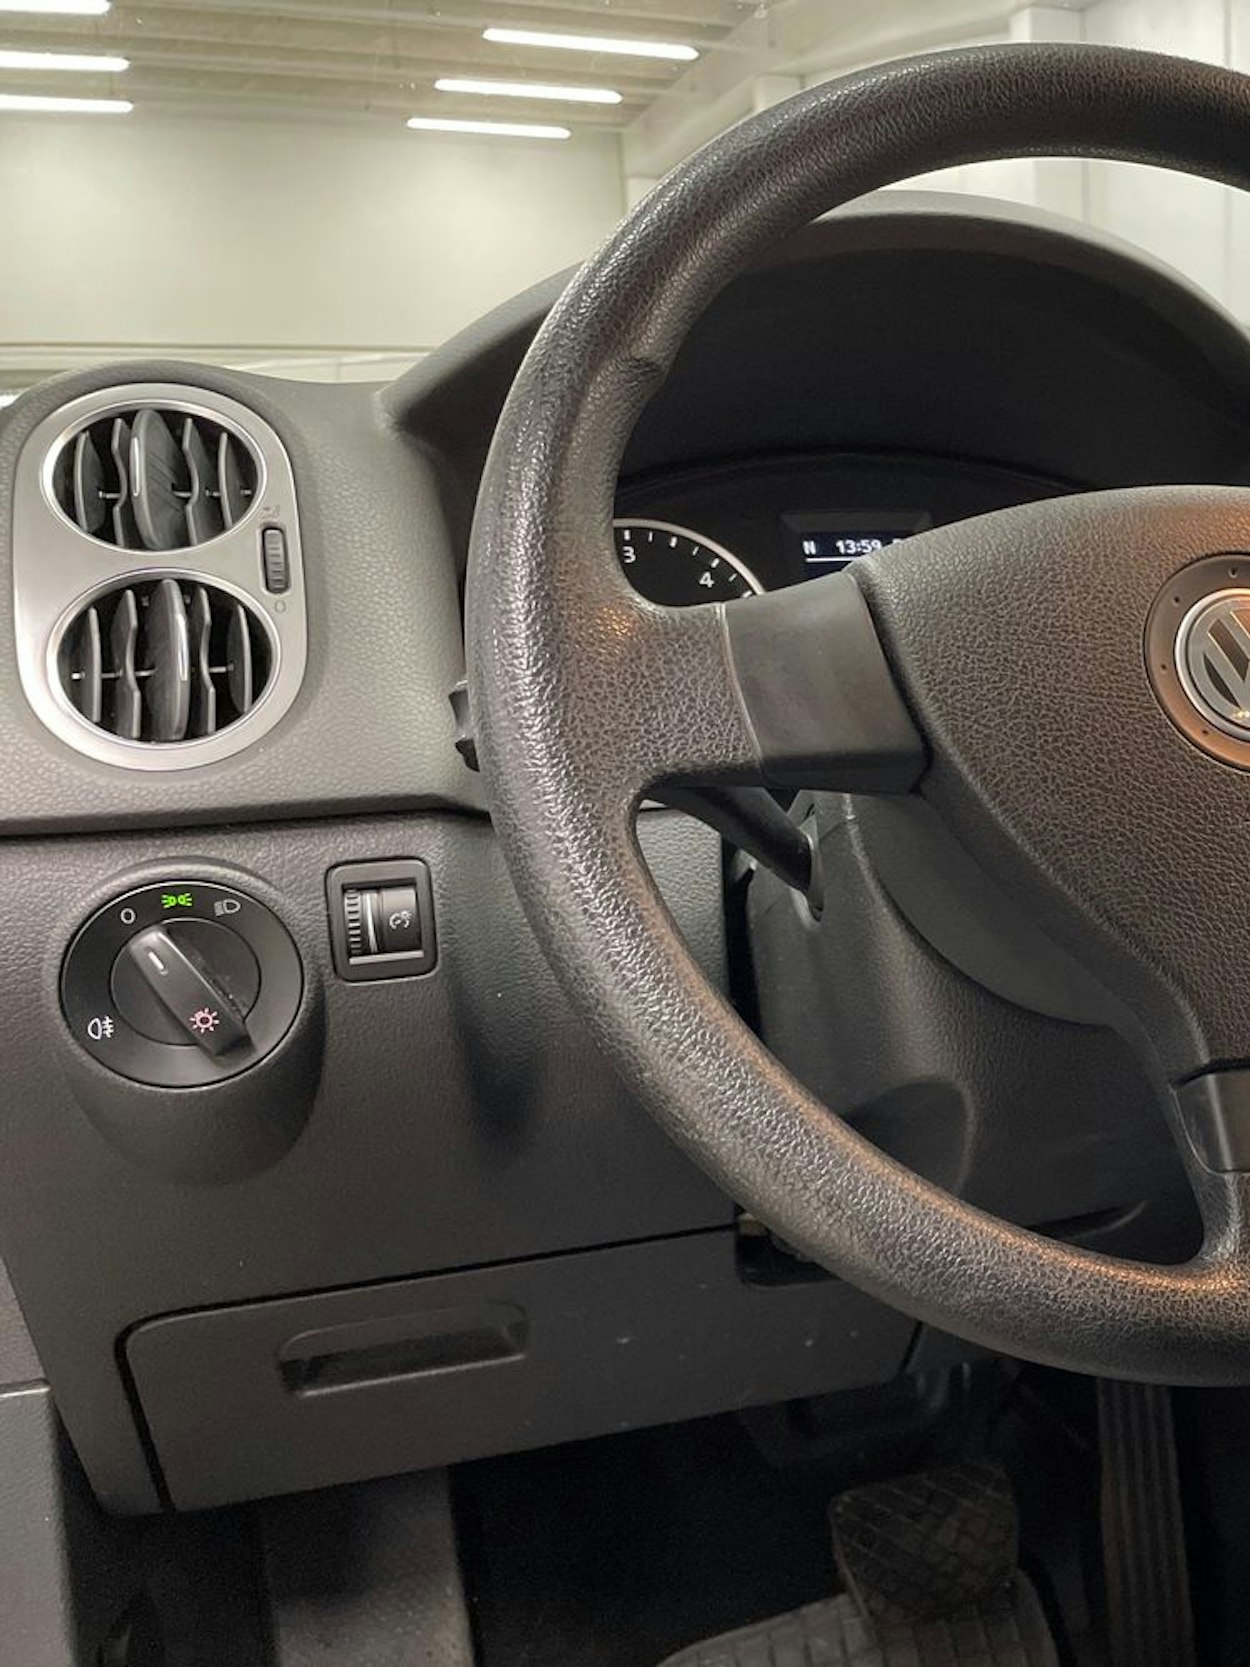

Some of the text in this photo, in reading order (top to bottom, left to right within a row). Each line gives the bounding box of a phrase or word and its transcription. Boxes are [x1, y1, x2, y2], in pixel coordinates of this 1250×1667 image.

[622, 545, 637, 564] 3
[835, 539, 882, 554] 13:59
[698, 571, 715, 589] 4
